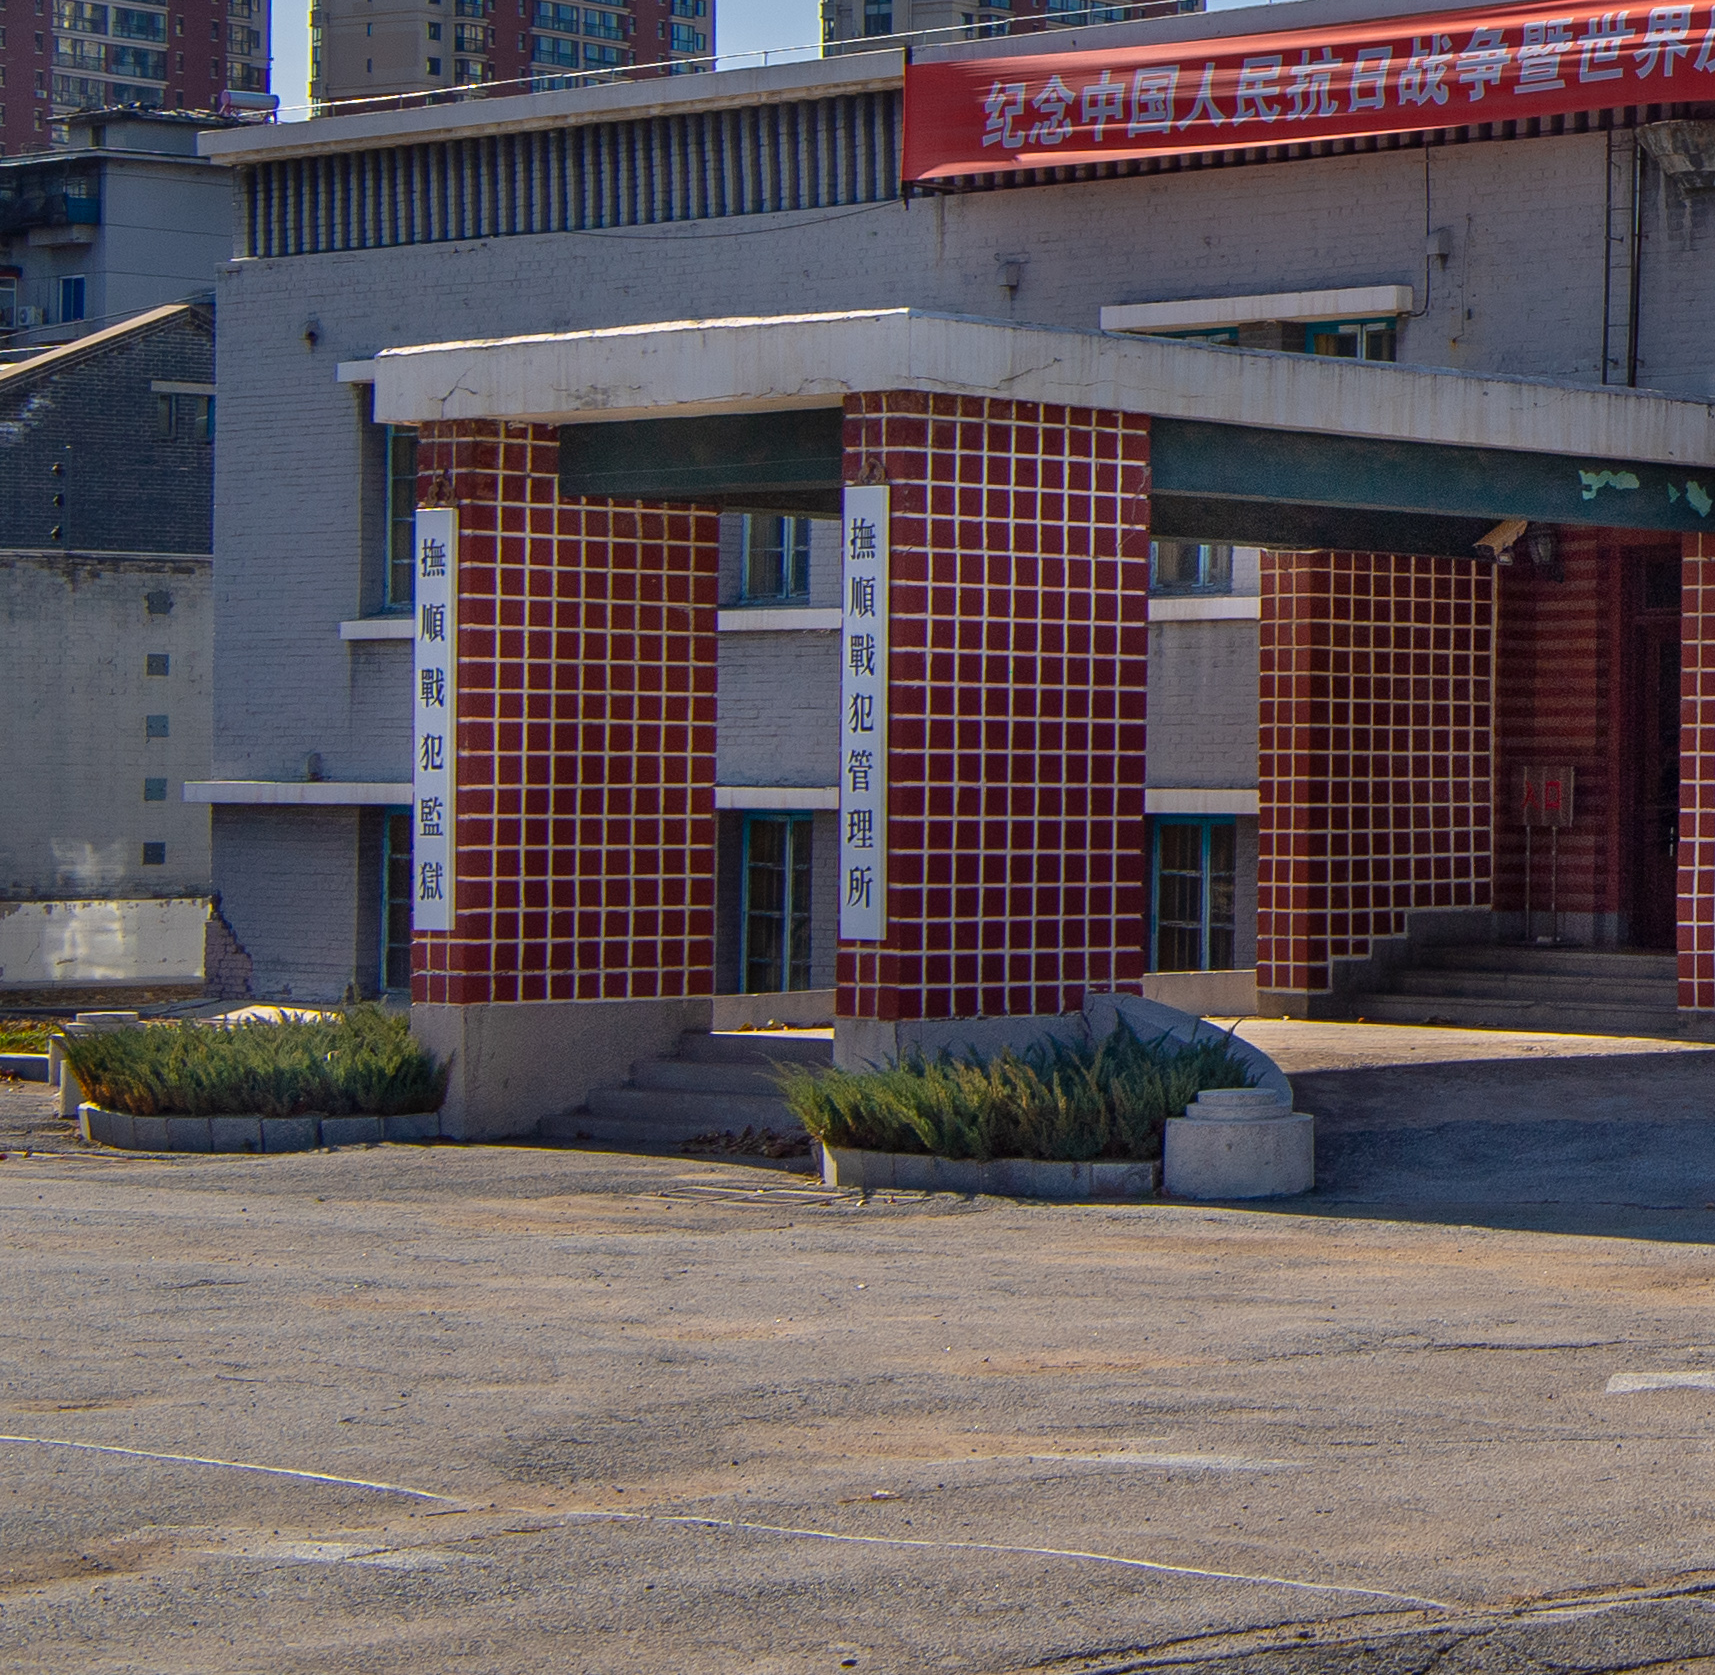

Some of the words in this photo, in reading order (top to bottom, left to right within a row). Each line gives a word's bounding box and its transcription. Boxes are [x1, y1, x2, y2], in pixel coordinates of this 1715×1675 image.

[419, 537, 446, 900] 撫順戰犯監獄
[847, 517, 876, 909] 撫順戰犯管理所
[1521, 780, 1562, 811] 入口
